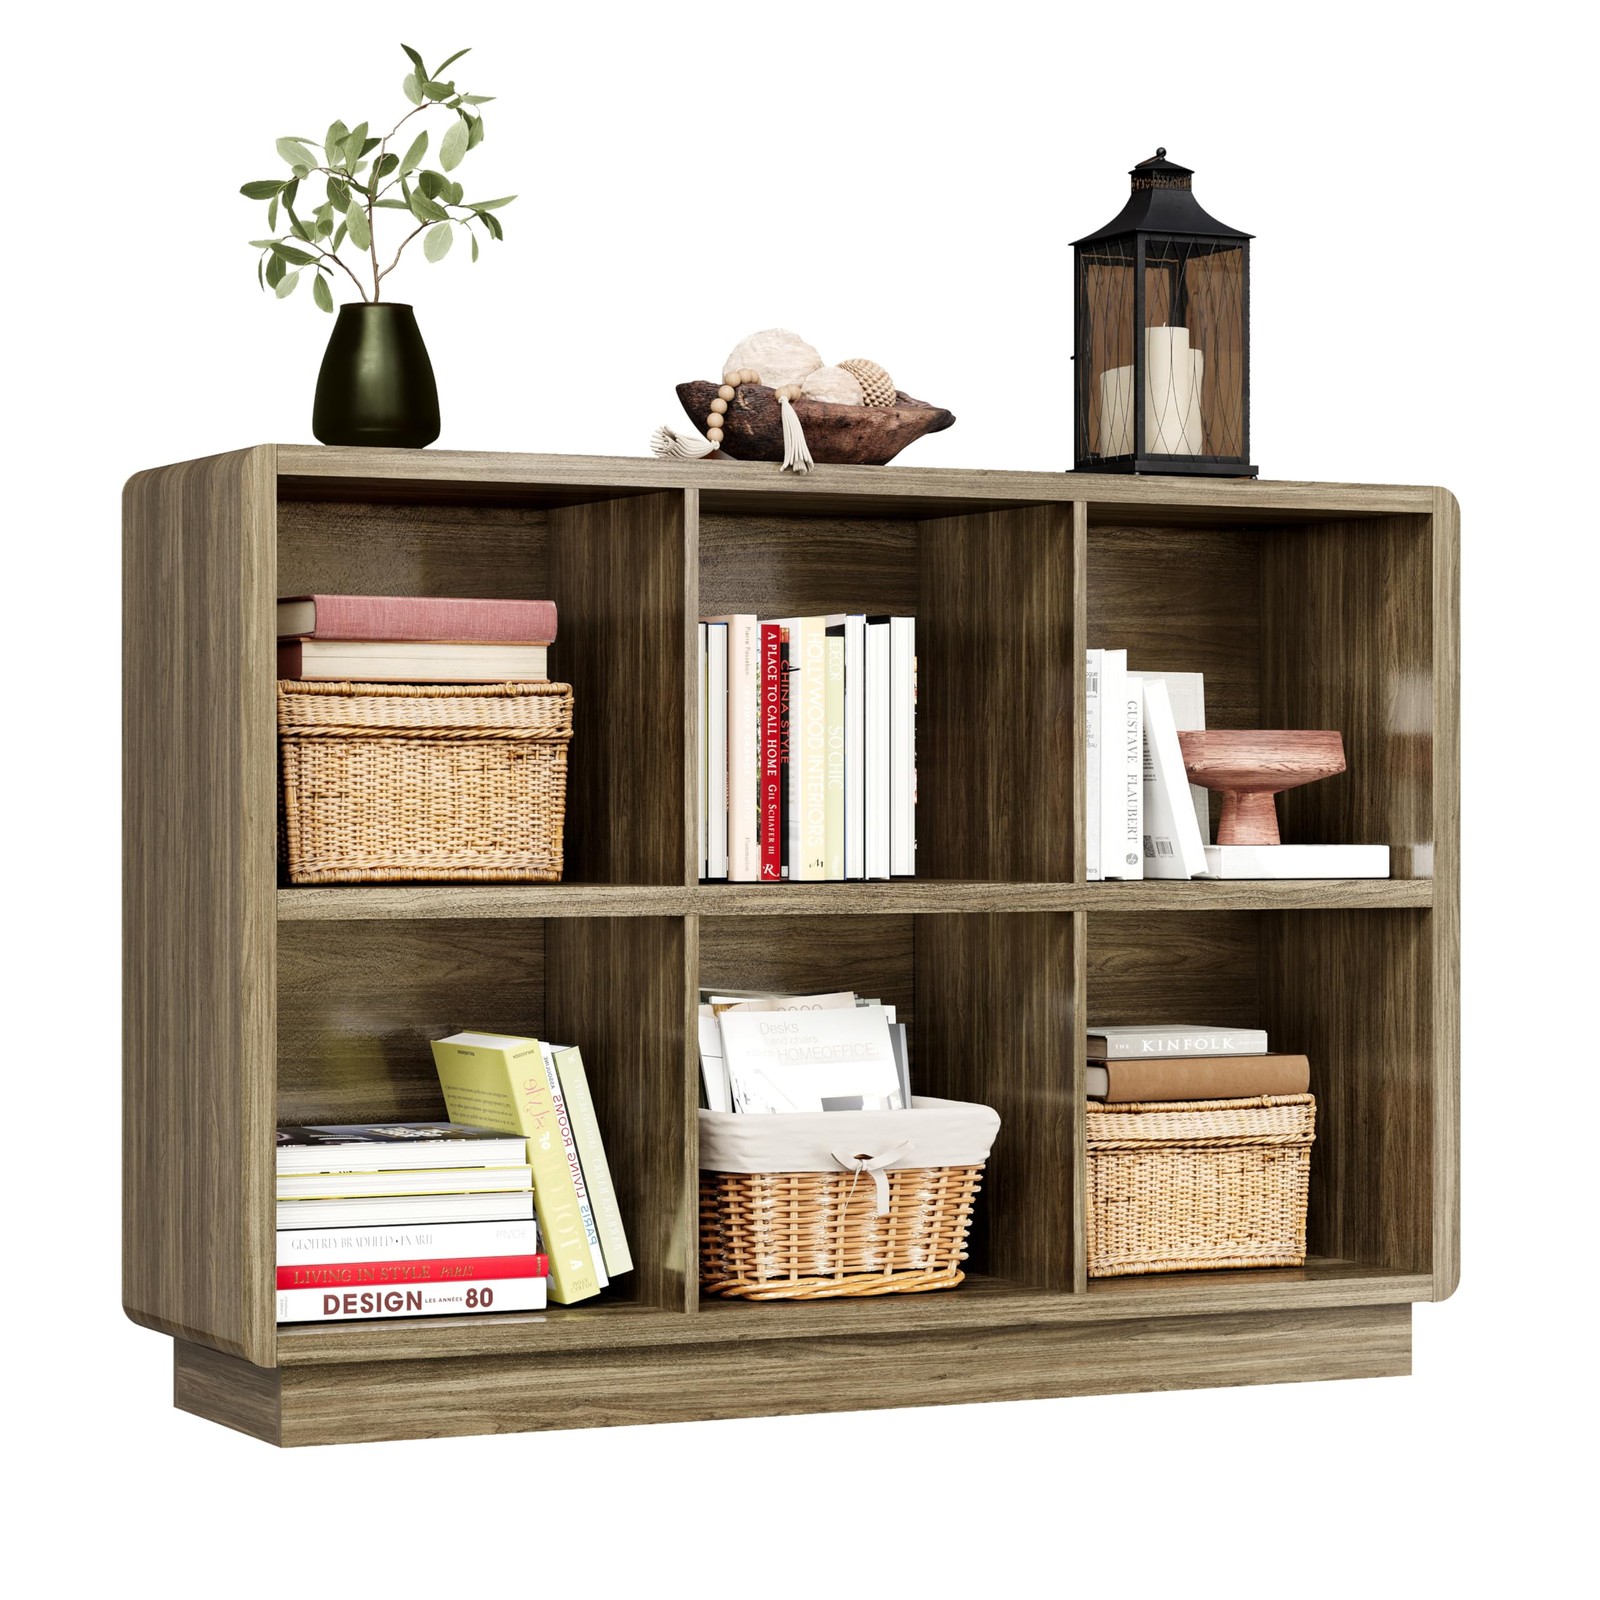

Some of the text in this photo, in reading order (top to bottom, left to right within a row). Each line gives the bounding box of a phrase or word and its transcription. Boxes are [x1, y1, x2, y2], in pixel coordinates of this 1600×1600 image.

[767, 632, 777, 776] A PLACE TO CALL HOME
[780, 660, 790, 764] CHINA STYLE
[807, 632, 824, 752] HOLLYWOOD
[828, 726, 842, 790] SO CHIC
[1127, 700, 1138, 844] GUSTAVE FLAUBERT
[807, 756, 824, 847] INTERIORS
[760, 1021, 799, 1035] Desks
[1142, 1037, 1234, 1052] KINFOLK
[294, 1265, 474, 1284] LIVING IN STYLE PARIS
[323, 1290, 423, 1316] DESIGN
[465, 1287, 494, 1308] 80
